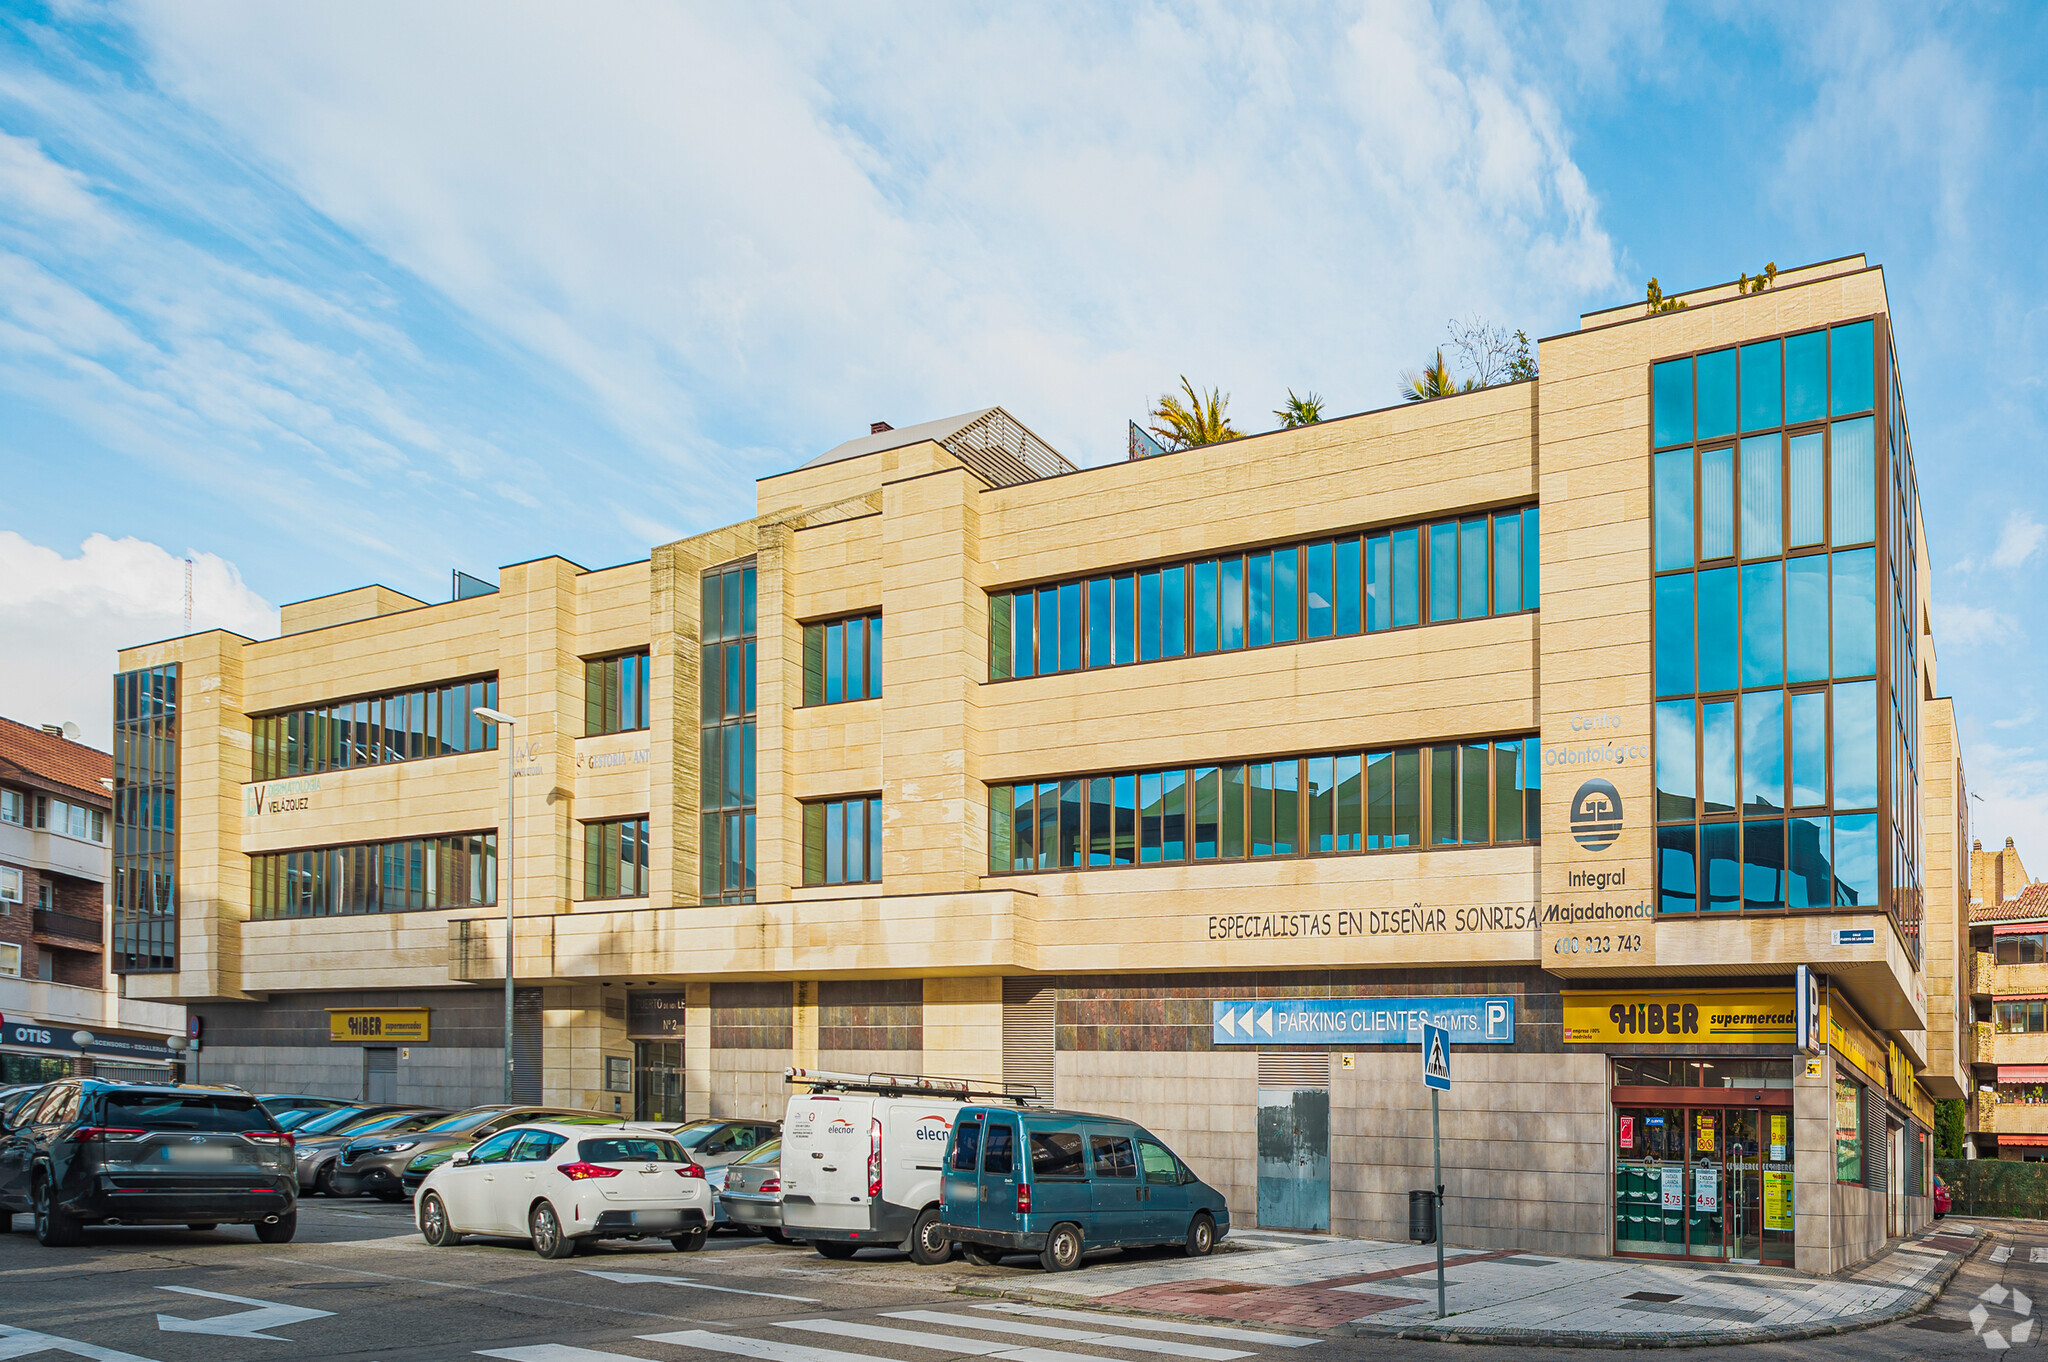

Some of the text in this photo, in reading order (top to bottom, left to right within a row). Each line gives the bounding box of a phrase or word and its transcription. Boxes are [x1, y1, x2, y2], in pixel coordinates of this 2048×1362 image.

[1571, 713, 1621, 731] Centro
[1545, 742, 1649, 766] Odontológico
[268, 797, 308, 813] VELÁZQUEZ
[1569, 868, 1625, 889] Integral
[1209, 903, 1541, 939] ESPECIALISTAS EN DISEÑAR SONRISA
[1542, 901, 1654, 924] Majadahonda
[1554, 934, 1641, 953] 608 323 743
[672, 1019, 677, 1031] 2
[1278, 1005, 1505, 1035] PARKING CLIENTES 50 MTS. P
[15, 1027, 51, 1044] OTIS
[134, 1045, 167, 1053] ESCALERAS
[828, 1125, 854, 1134] elecnor
[916, 1126, 950, 1141] elecn
[1664, 1193, 1681, 1204] 3,75
[1697, 1194, 1716, 1206] 4,50
